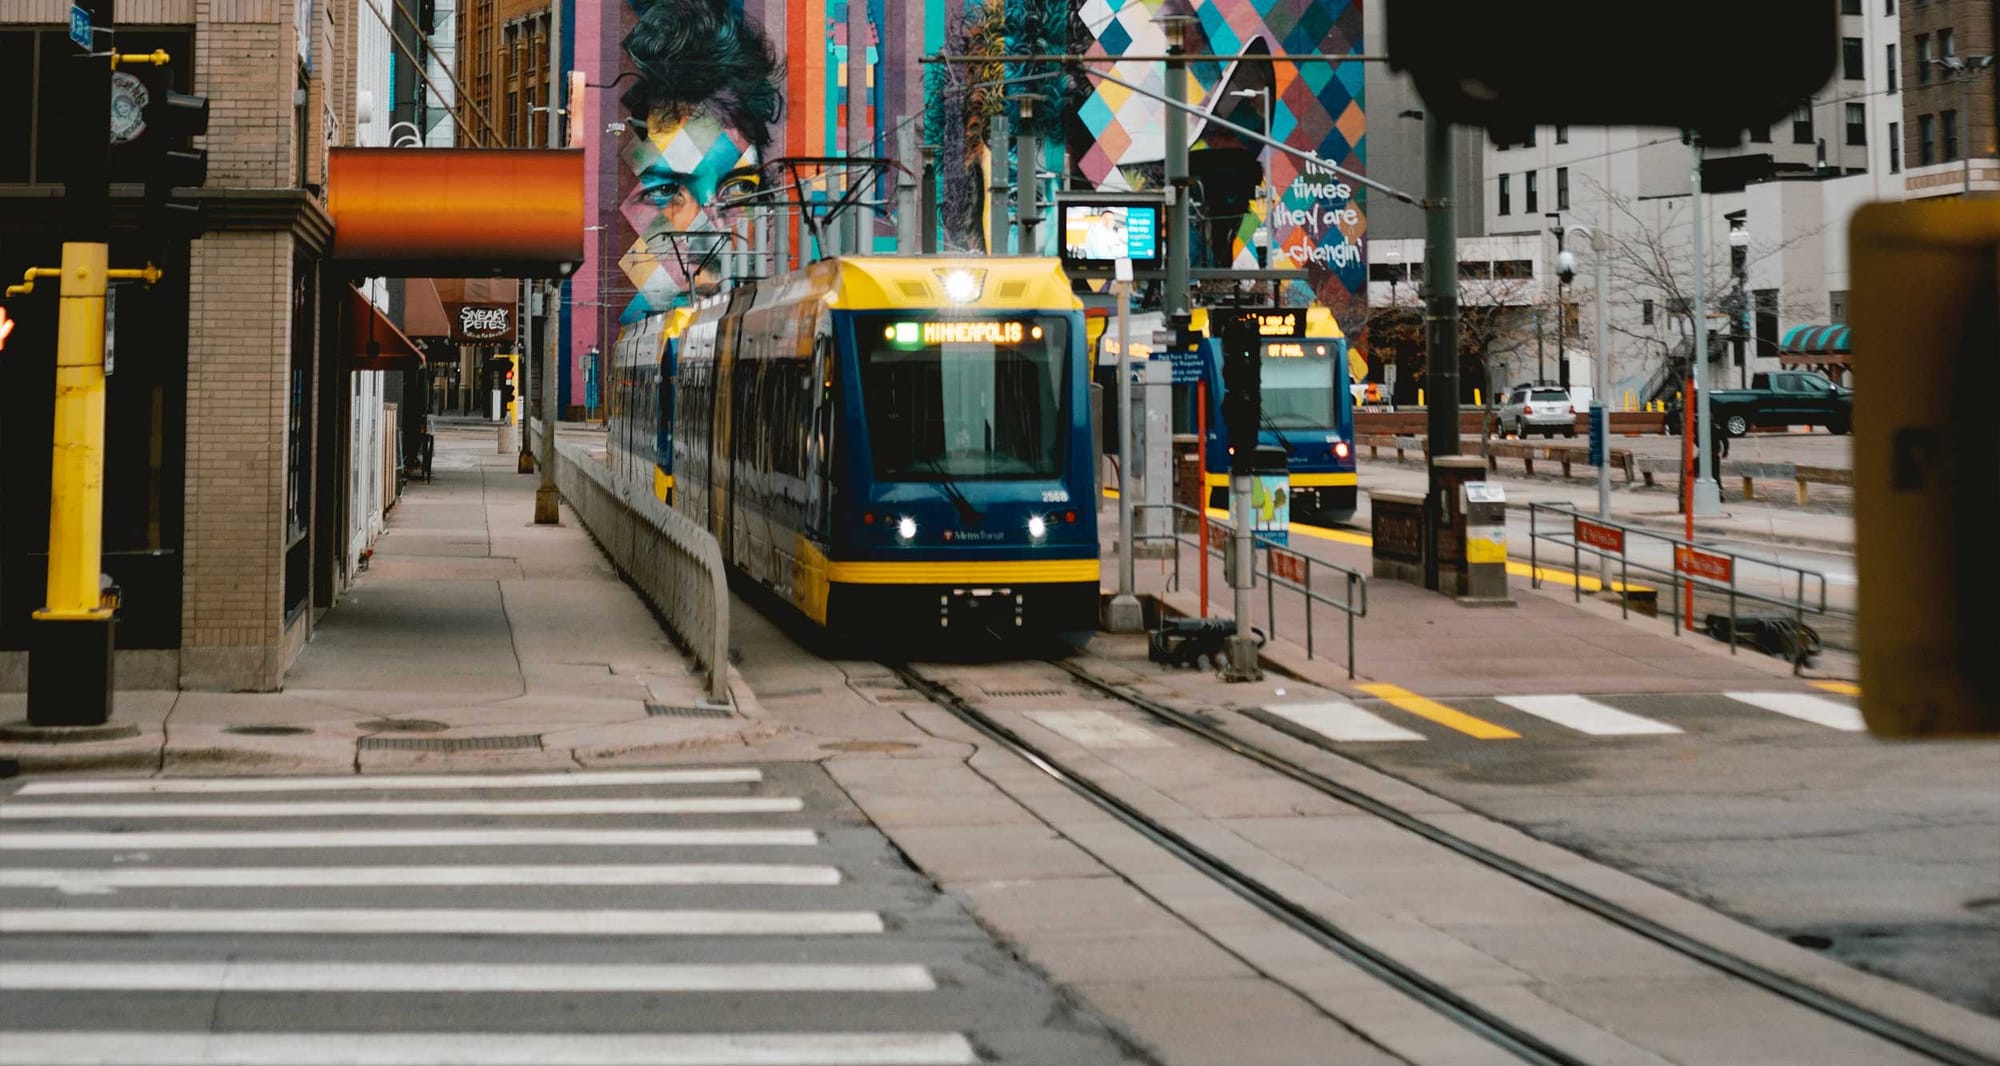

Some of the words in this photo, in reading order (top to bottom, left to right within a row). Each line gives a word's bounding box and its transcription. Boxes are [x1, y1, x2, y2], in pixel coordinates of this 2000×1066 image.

[1291, 176, 1352, 200] times
[1273, 201, 1320, 235] they
[1323, 208, 1358, 225] are
[460, 307, 508, 320] SNEAKY
[924, 322, 1023, 343] MINNEAPOLIS
